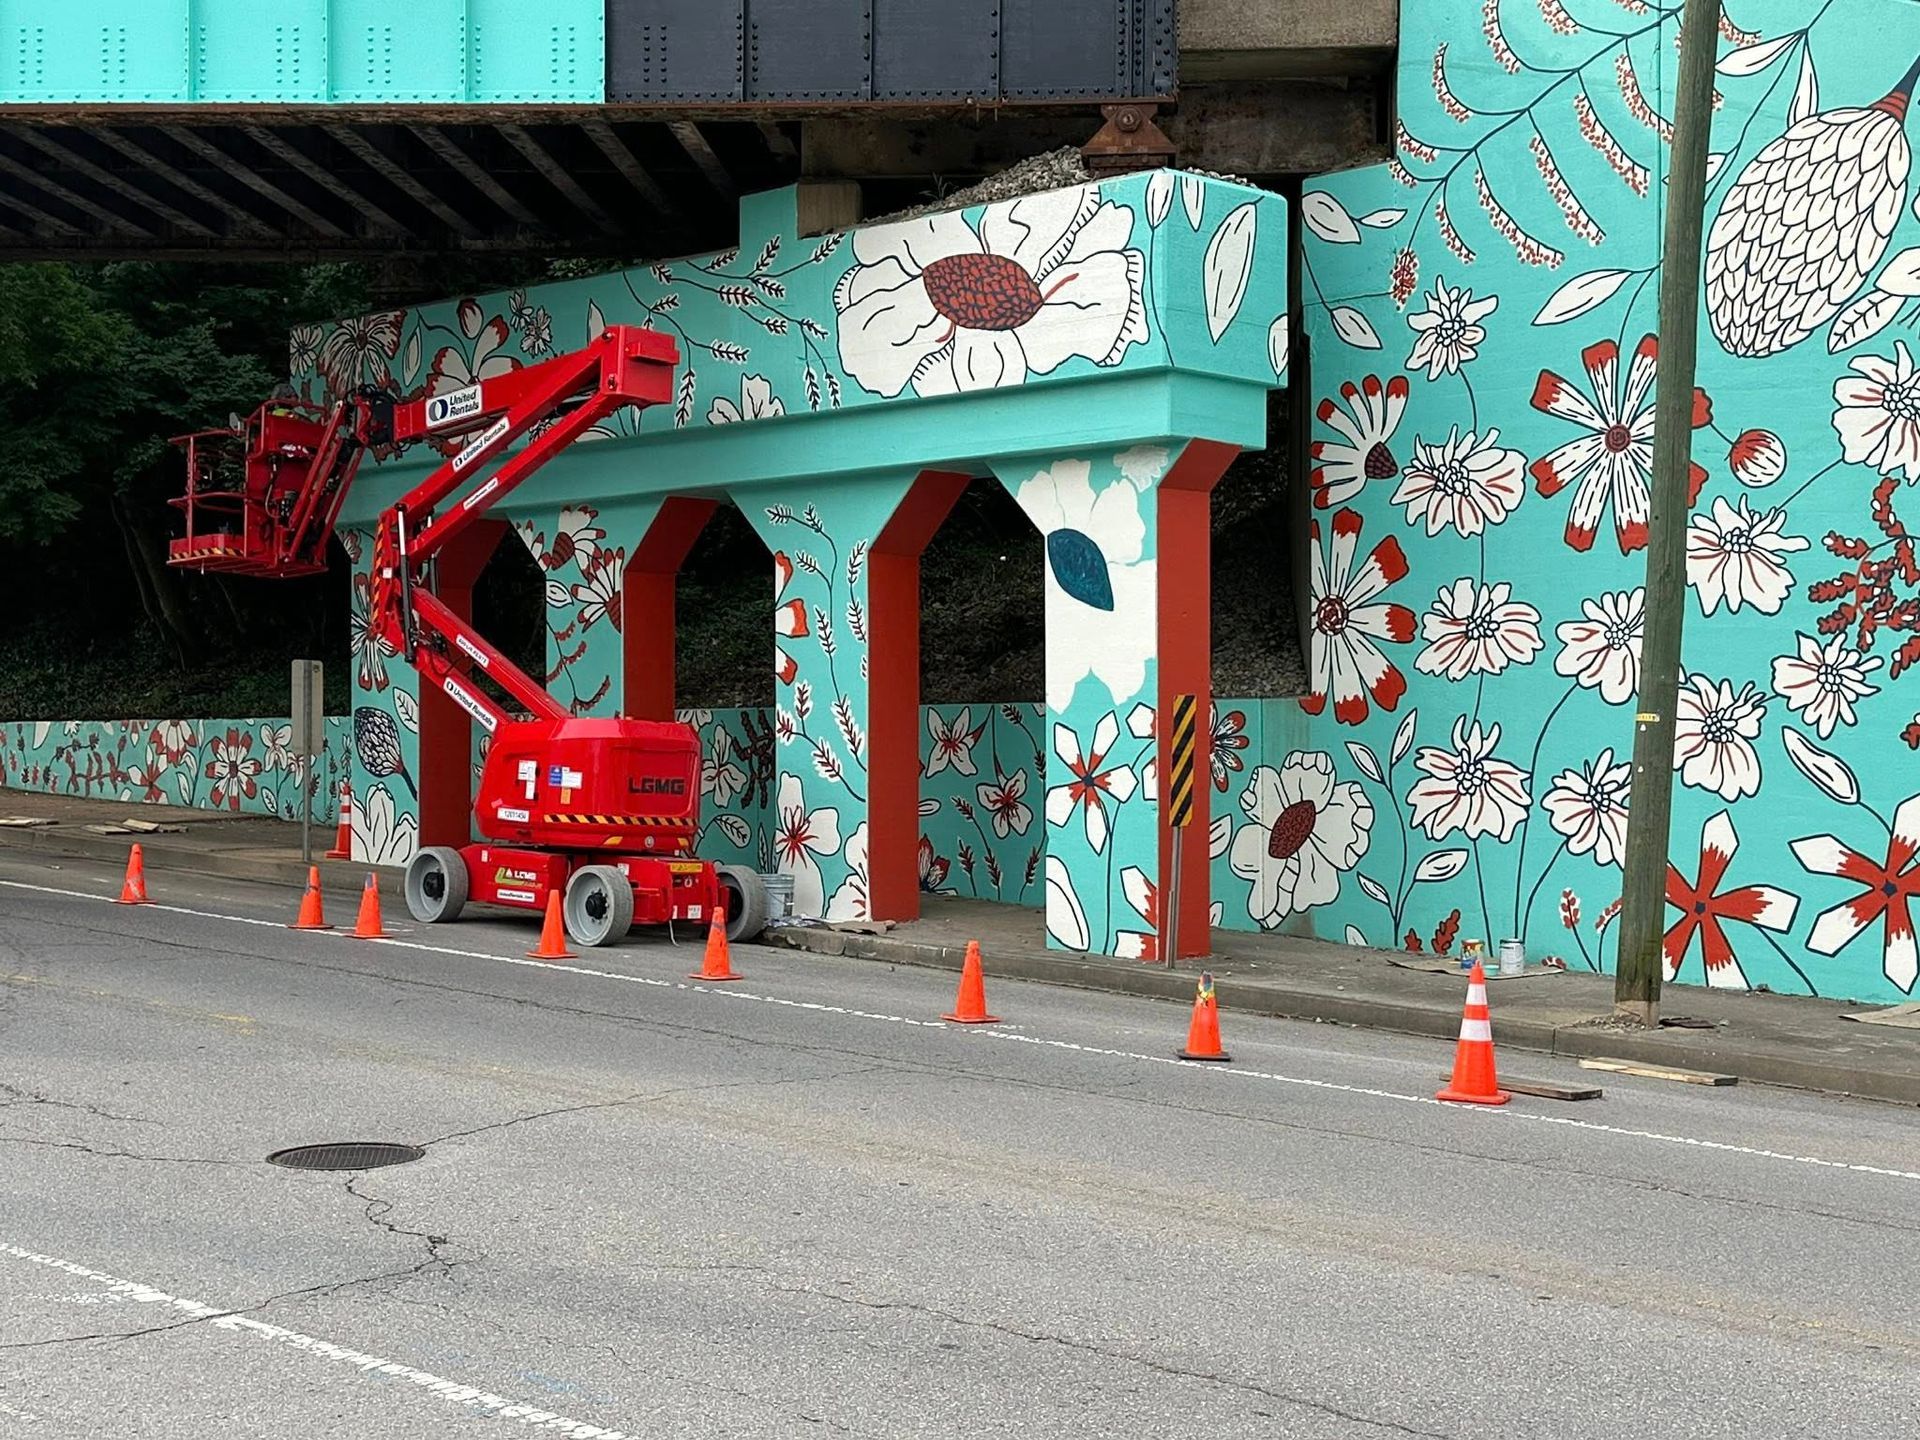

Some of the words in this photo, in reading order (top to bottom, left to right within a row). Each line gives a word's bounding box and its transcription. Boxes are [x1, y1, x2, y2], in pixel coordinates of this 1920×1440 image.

[450, 388, 477, 405] United
[450, 401, 479, 416] Rentals
[463, 440, 484, 460] United
[484, 422, 506, 444] Rentals
[453, 688, 473, 708] United
[472, 704, 493, 726] Rentals
[628, 777, 685, 795] LGMG
